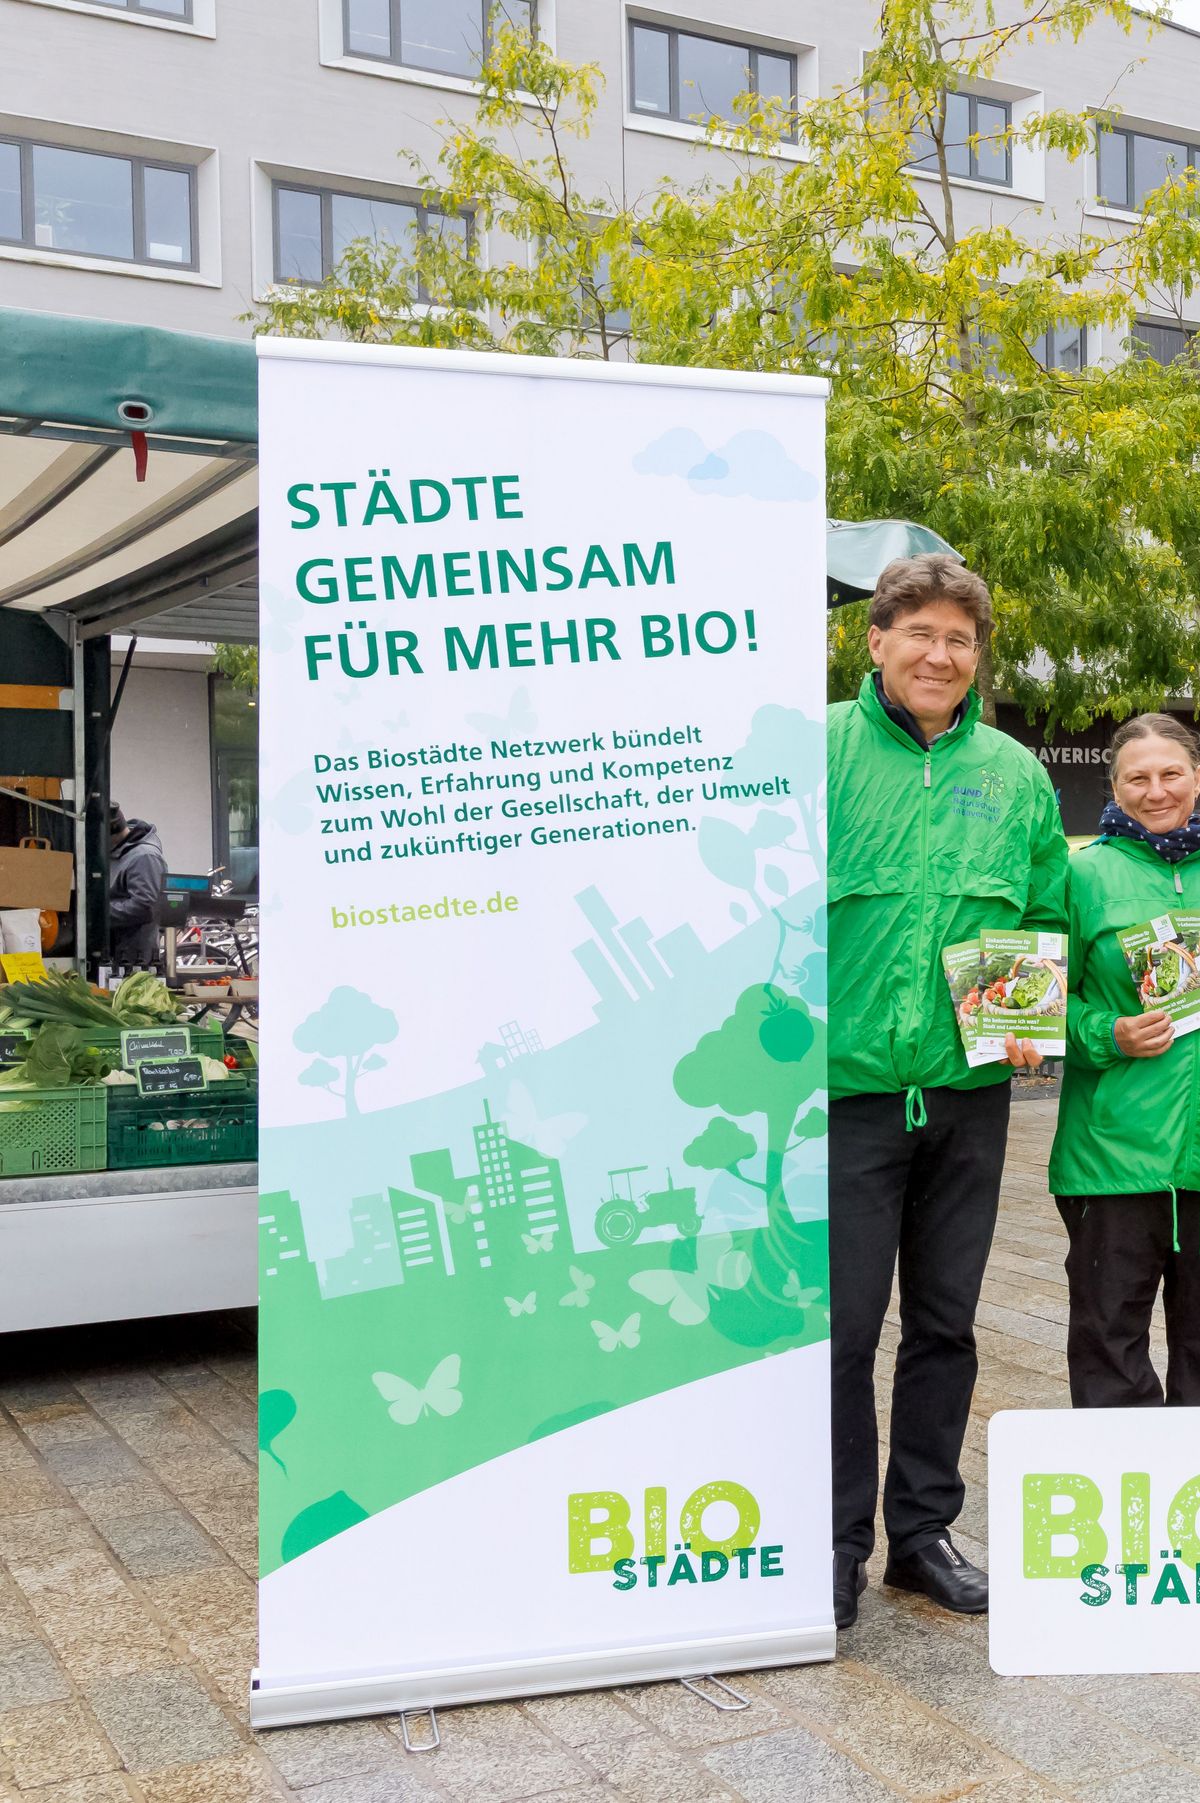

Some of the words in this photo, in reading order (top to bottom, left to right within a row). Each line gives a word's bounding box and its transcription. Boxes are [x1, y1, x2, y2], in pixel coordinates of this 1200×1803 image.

[287, 469, 523, 529] STÄDTE
[295, 541, 676, 604] GEMEINSAM
[304, 620, 423, 681] FÜR
[444, 617, 621, 672] MEHR
[641, 609, 759, 658] BIO!
[314, 755, 359, 773] Das
[368, 743, 482, 769] Biostädte
[491, 732, 605, 759] Netzwerk
[613, 725, 703, 749] bündelt
[316, 782, 412, 803] Wissen,
[421, 772, 541, 795] Erfahrung
[550, 762, 593, 784] und
[602, 756, 733, 780] Kompetenz
[321, 816, 373, 833] zum
[381, 804, 445, 828] Wohl
[454, 802, 493, 822] der
[502, 788, 649, 818] Gesellschaft,
[657, 785, 694, 804] der
[702, 776, 790, 800] Umwelt
[324, 841, 372, 864] und
[381, 832, 522, 859] zukünftiger
[531, 818, 696, 845] Generationen.
[331, 891, 520, 929] biostaedte.de
[568, 1480, 761, 1574] BIO
[613, 1543, 783, 1590] STÄDTE
